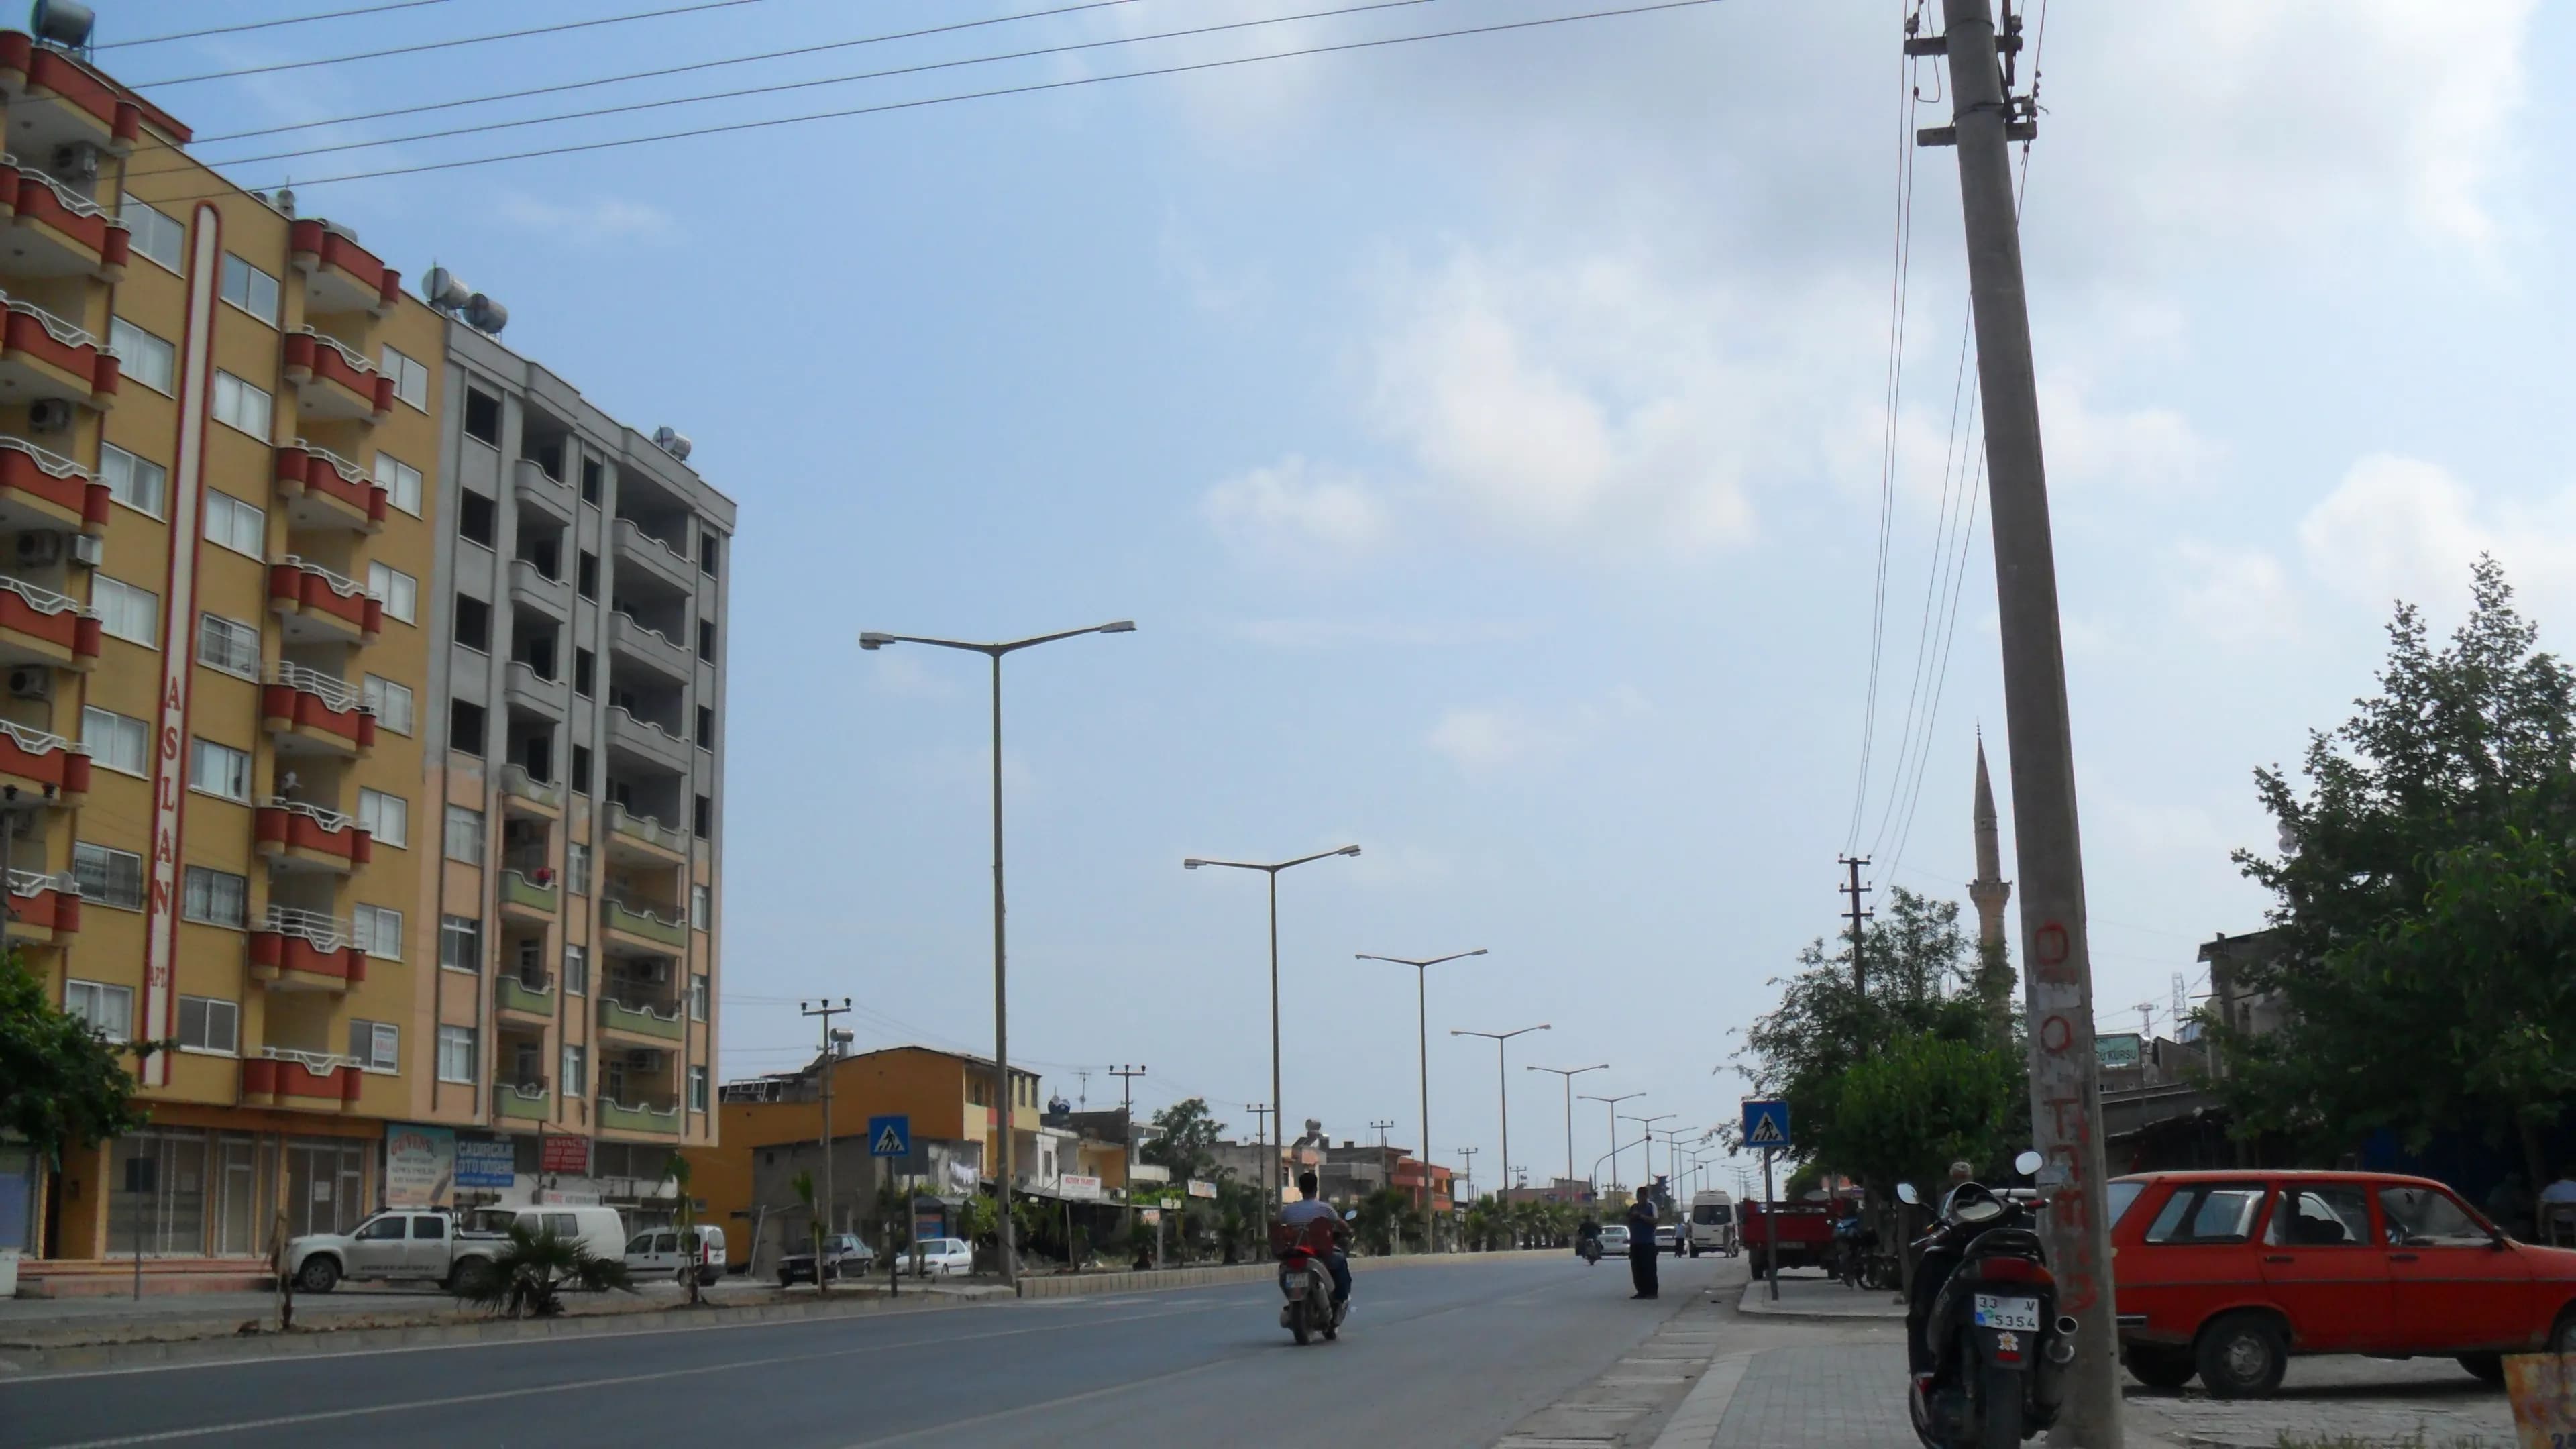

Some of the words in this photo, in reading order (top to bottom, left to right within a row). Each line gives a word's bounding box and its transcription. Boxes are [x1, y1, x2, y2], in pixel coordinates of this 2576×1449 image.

[152, 676, 181, 915] ASLAN
[1980, 1297, 1998, 1309] 33
[1995, 1315, 2035, 1328] 5354
